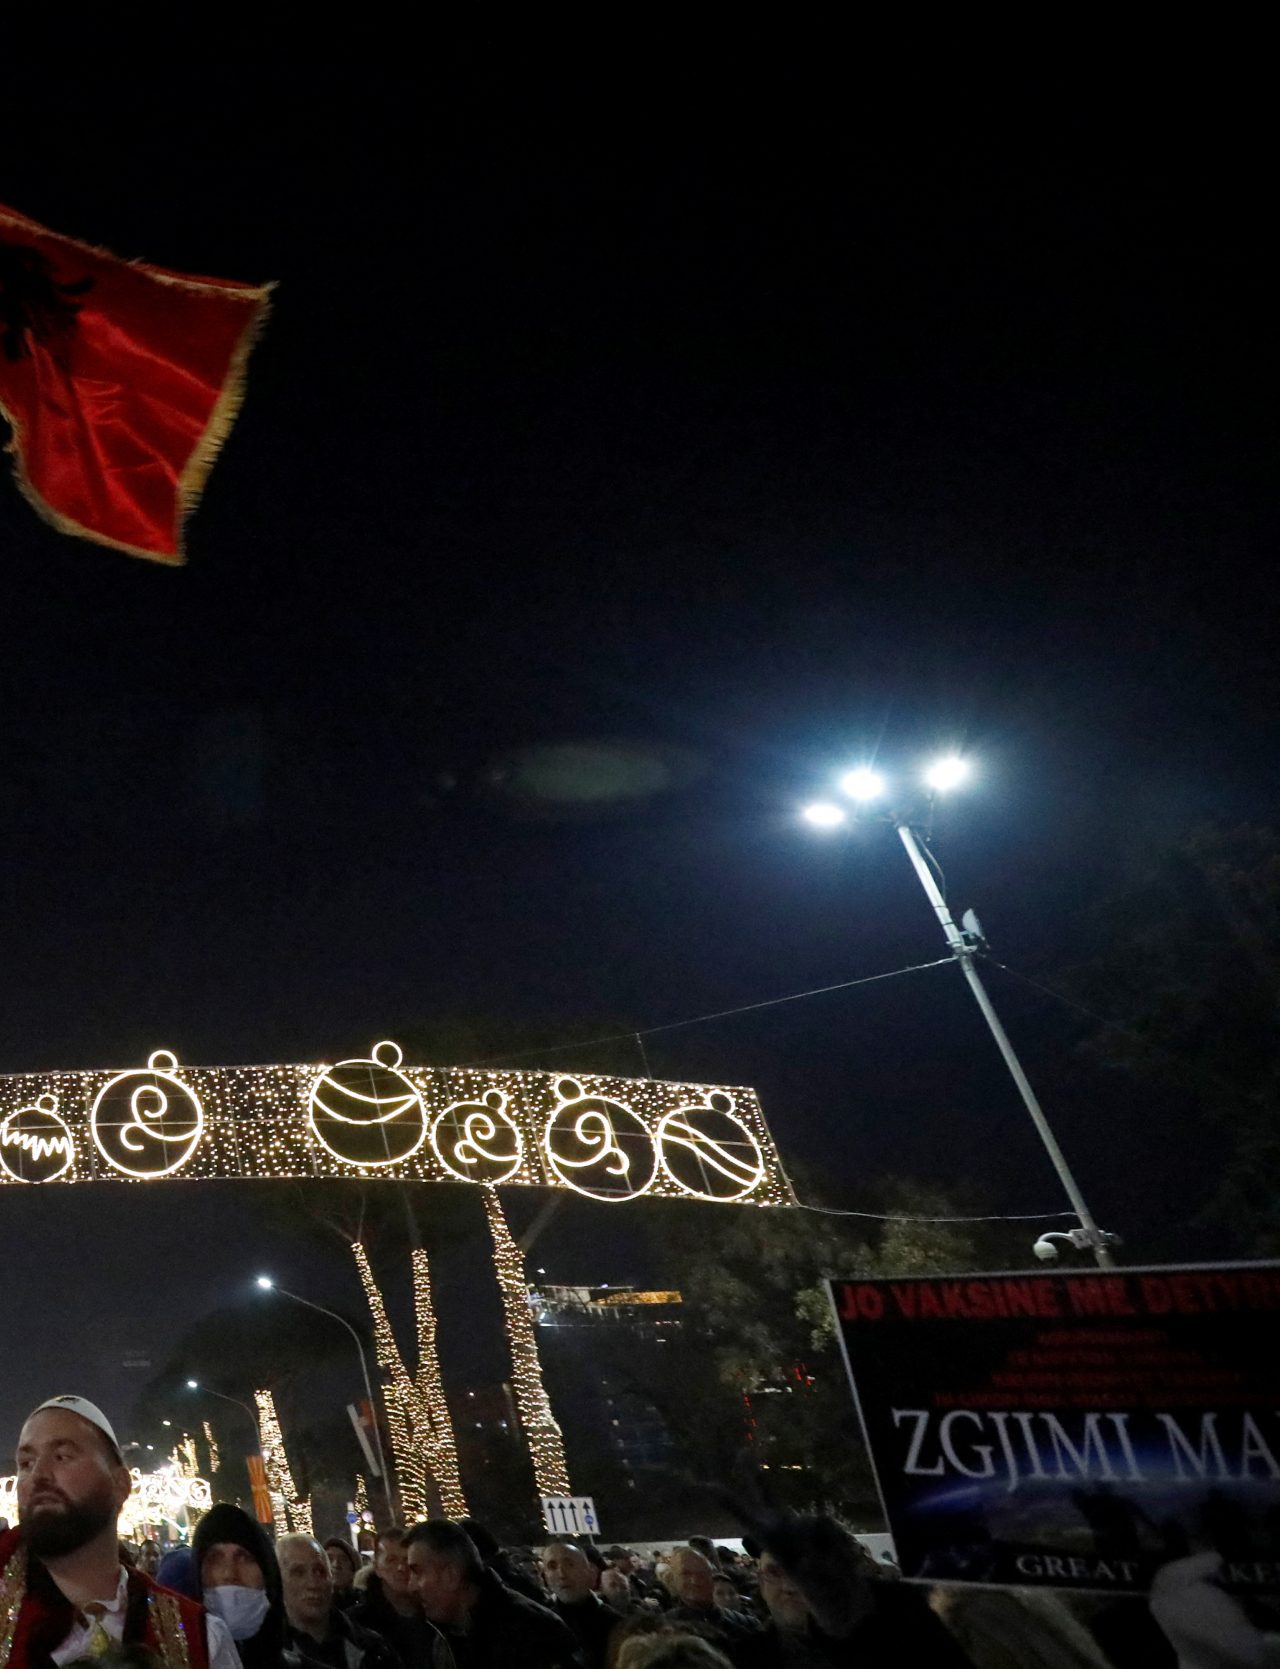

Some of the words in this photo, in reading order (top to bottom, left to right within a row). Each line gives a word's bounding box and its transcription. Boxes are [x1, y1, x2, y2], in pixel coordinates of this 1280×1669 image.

[841, 1284, 884, 1320] JO
[890, 1279, 1061, 1318] VAKSINE
[1140, 1273, 1280, 1313] DETYR
[892, 1408, 1147, 1493] ZGJIMI
[1156, 1410, 1280, 1482] MA
[1016, 1553, 1139, 1582] GREAT
